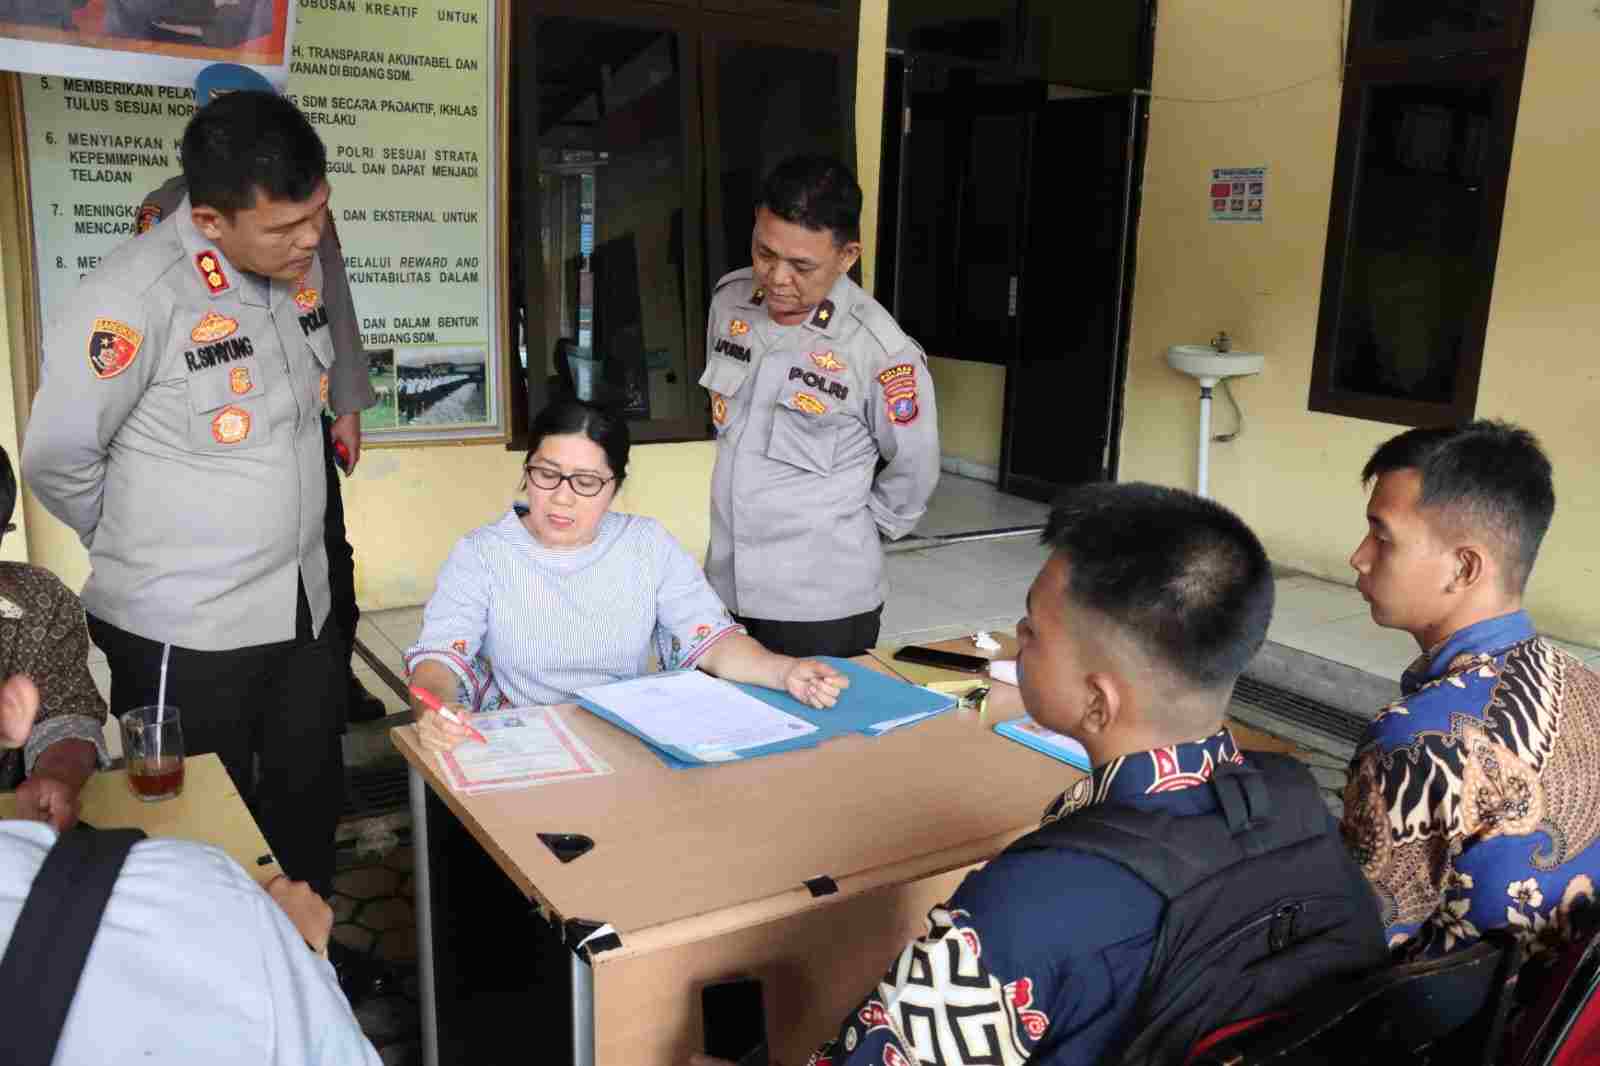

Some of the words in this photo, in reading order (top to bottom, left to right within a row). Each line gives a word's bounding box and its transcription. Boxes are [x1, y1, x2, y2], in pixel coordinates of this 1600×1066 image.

[365, 4, 418, 18] KREATIF
[438, 10, 478, 24] UNTUK
[307, 46, 384, 63] TRANSPARAN
[388, 53, 452, 69] AKUNTABEL
[456, 60, 478, 71] DAN
[329, 64, 341, 77] DI
[342, 65, 385, 79] BIDANG
[64, 78, 153, 97] MEMBERIKAN
[64, 96, 109, 112] TULUS
[115, 99, 162, 115] SESUAI
[302, 95, 328, 109] SDM
[331, 96, 376, 112] SECARA
[440, 104, 478, 117] IKHLAS
[45, 132, 57, 145] 6.
[68, 132, 163, 150] MENYIAPKAN
[69, 151, 169, 168] KEPEMIMPINAN
[336, 145, 374, 159] POLRI
[383, 148, 426, 161] SESUAI
[434, 150, 478, 163] STRATA
[70, 169, 133, 183] TELADAN
[362, 163, 385, 175] DAN
[392, 163, 425, 176] DAPAT
[432, 164, 479, 177] MENJADI
[49, 203, 64, 217] 7.
[343, 208, 367, 222] DAN
[373, 209, 435, 223] EKSTERNAL
[442, 210, 479, 223] UNTUK
[55, 255, 68, 269] 8.
[399, 256, 448, 268] REWARD
[455, 256, 479, 268] AND
[439, 271, 479, 283] DALAM
[363, 318, 386, 329] DAN
[393, 317, 431, 329] DALAM
[438, 316, 479, 328] BENTUK
[370, 332, 411, 345] BIDANG
[788, 366, 849, 400] POLRI
